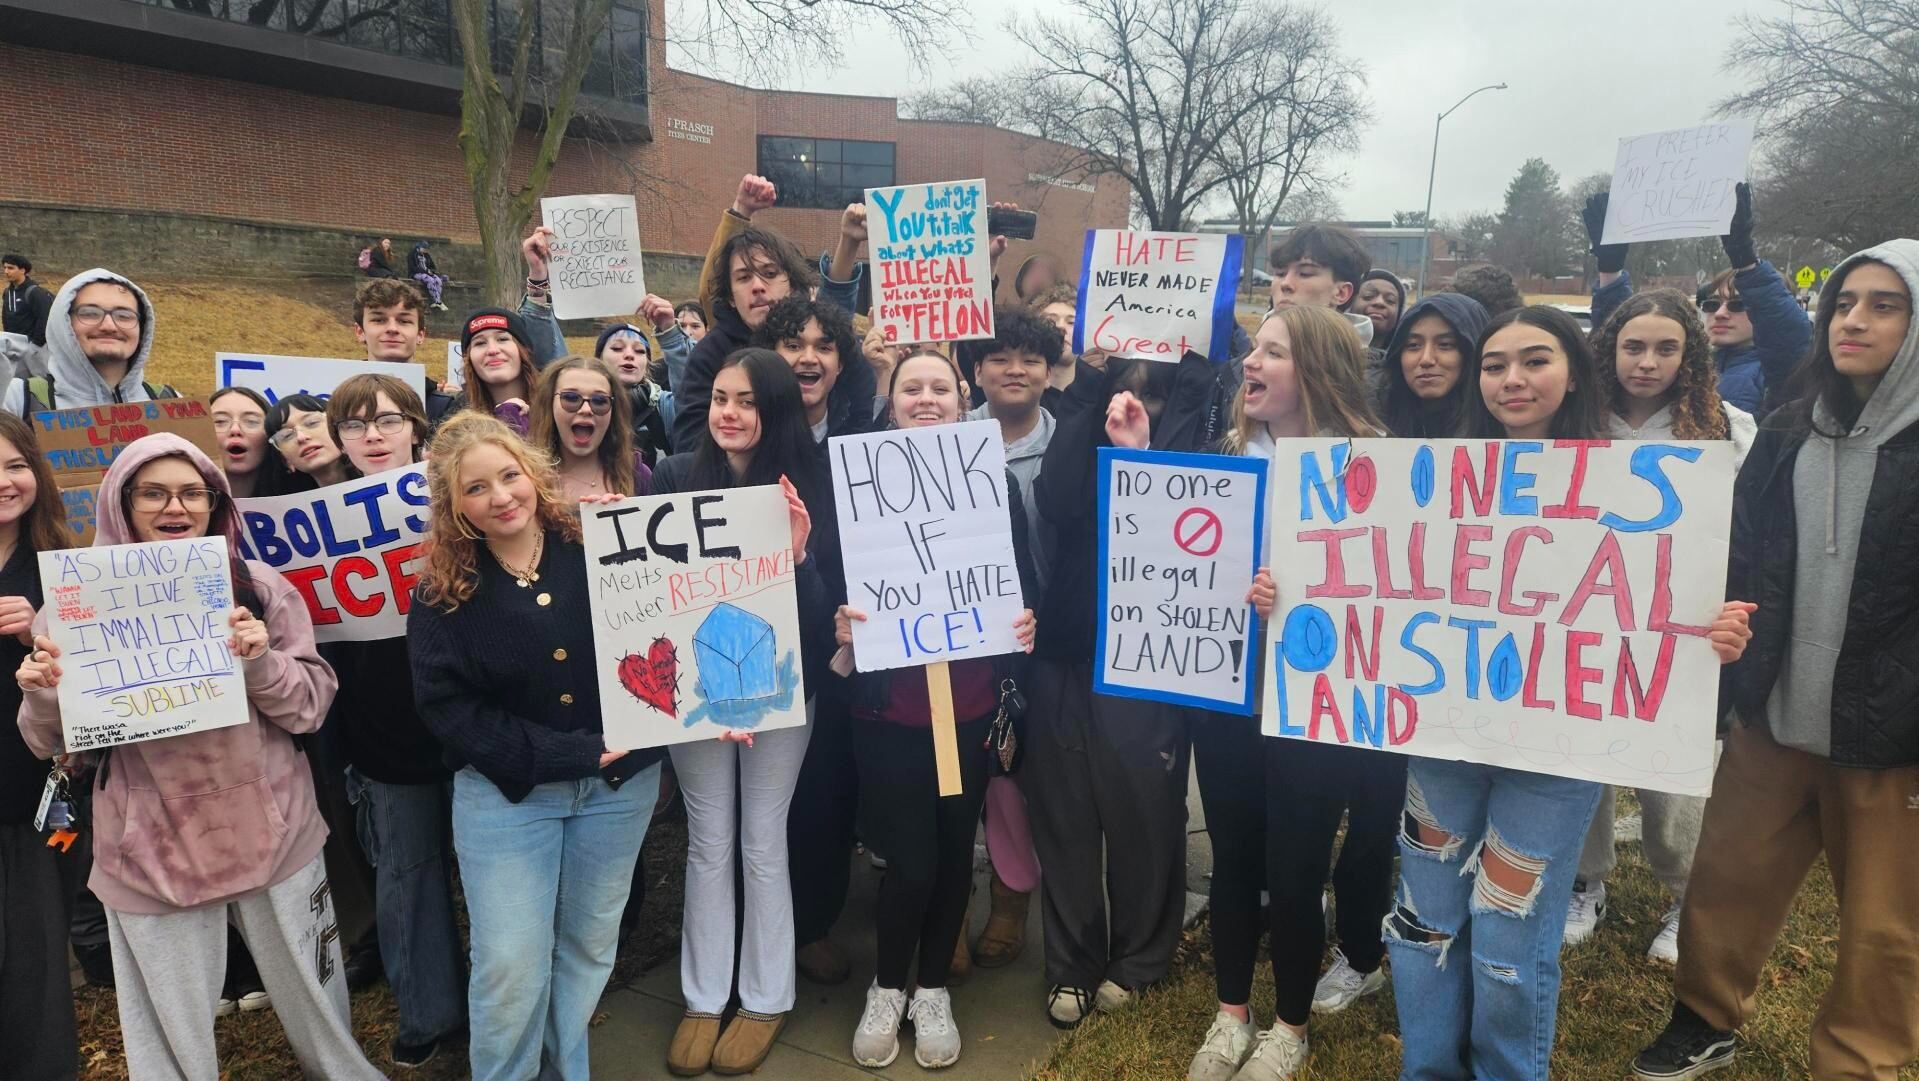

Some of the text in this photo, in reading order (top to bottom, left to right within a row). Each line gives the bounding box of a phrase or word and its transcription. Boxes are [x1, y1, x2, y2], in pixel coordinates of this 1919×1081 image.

[673, 118, 714, 136] PRASCH
[1621, 165, 1650, 190] MY
[550, 207, 631, 239] RESPECT
[571, 239, 630, 256] EXISTENCE
[1115, 231, 1199, 266] HATE
[880, 257, 974, 288] ILLEGAL
[1096, 270, 1213, 293] NEVER MADE
[470, 317, 506, 329] Supreme
[1104, 293, 1198, 320] America
[1093, 315, 1193, 357] Great
[35, 409, 93, 432] THIS
[92, 404, 142, 427] LAND
[87, 424, 149, 447] LAND
[46, 449, 100, 470] THIS
[839, 434, 1002, 522] HONK
[1300, 442, 1377, 524] NO
[595, 495, 742, 567] ICE
[1114, 512, 1140, 535] is
[111, 545, 178, 579] LONG
[184, 542, 222, 574] AS
[903, 518, 948, 575] IF
[100, 586, 124, 612] I
[134, 575, 186, 608] LIVE
[668, 549, 795, 610] RESISTANCE
[862, 564, 1018, 612] YOU HATE
[1111, 556, 1217, 602] illegal
[1296, 522, 1716, 638] ILLEGAL
[1111, 604, 1143, 623] on
[899, 606, 986, 659] ICE!
[1112, 632, 1245, 684] LAND!
[1282, 603, 1678, 722] ON STOLEN
[1274, 641, 1419, 748] LAND
[128, 731, 150, 740] where
